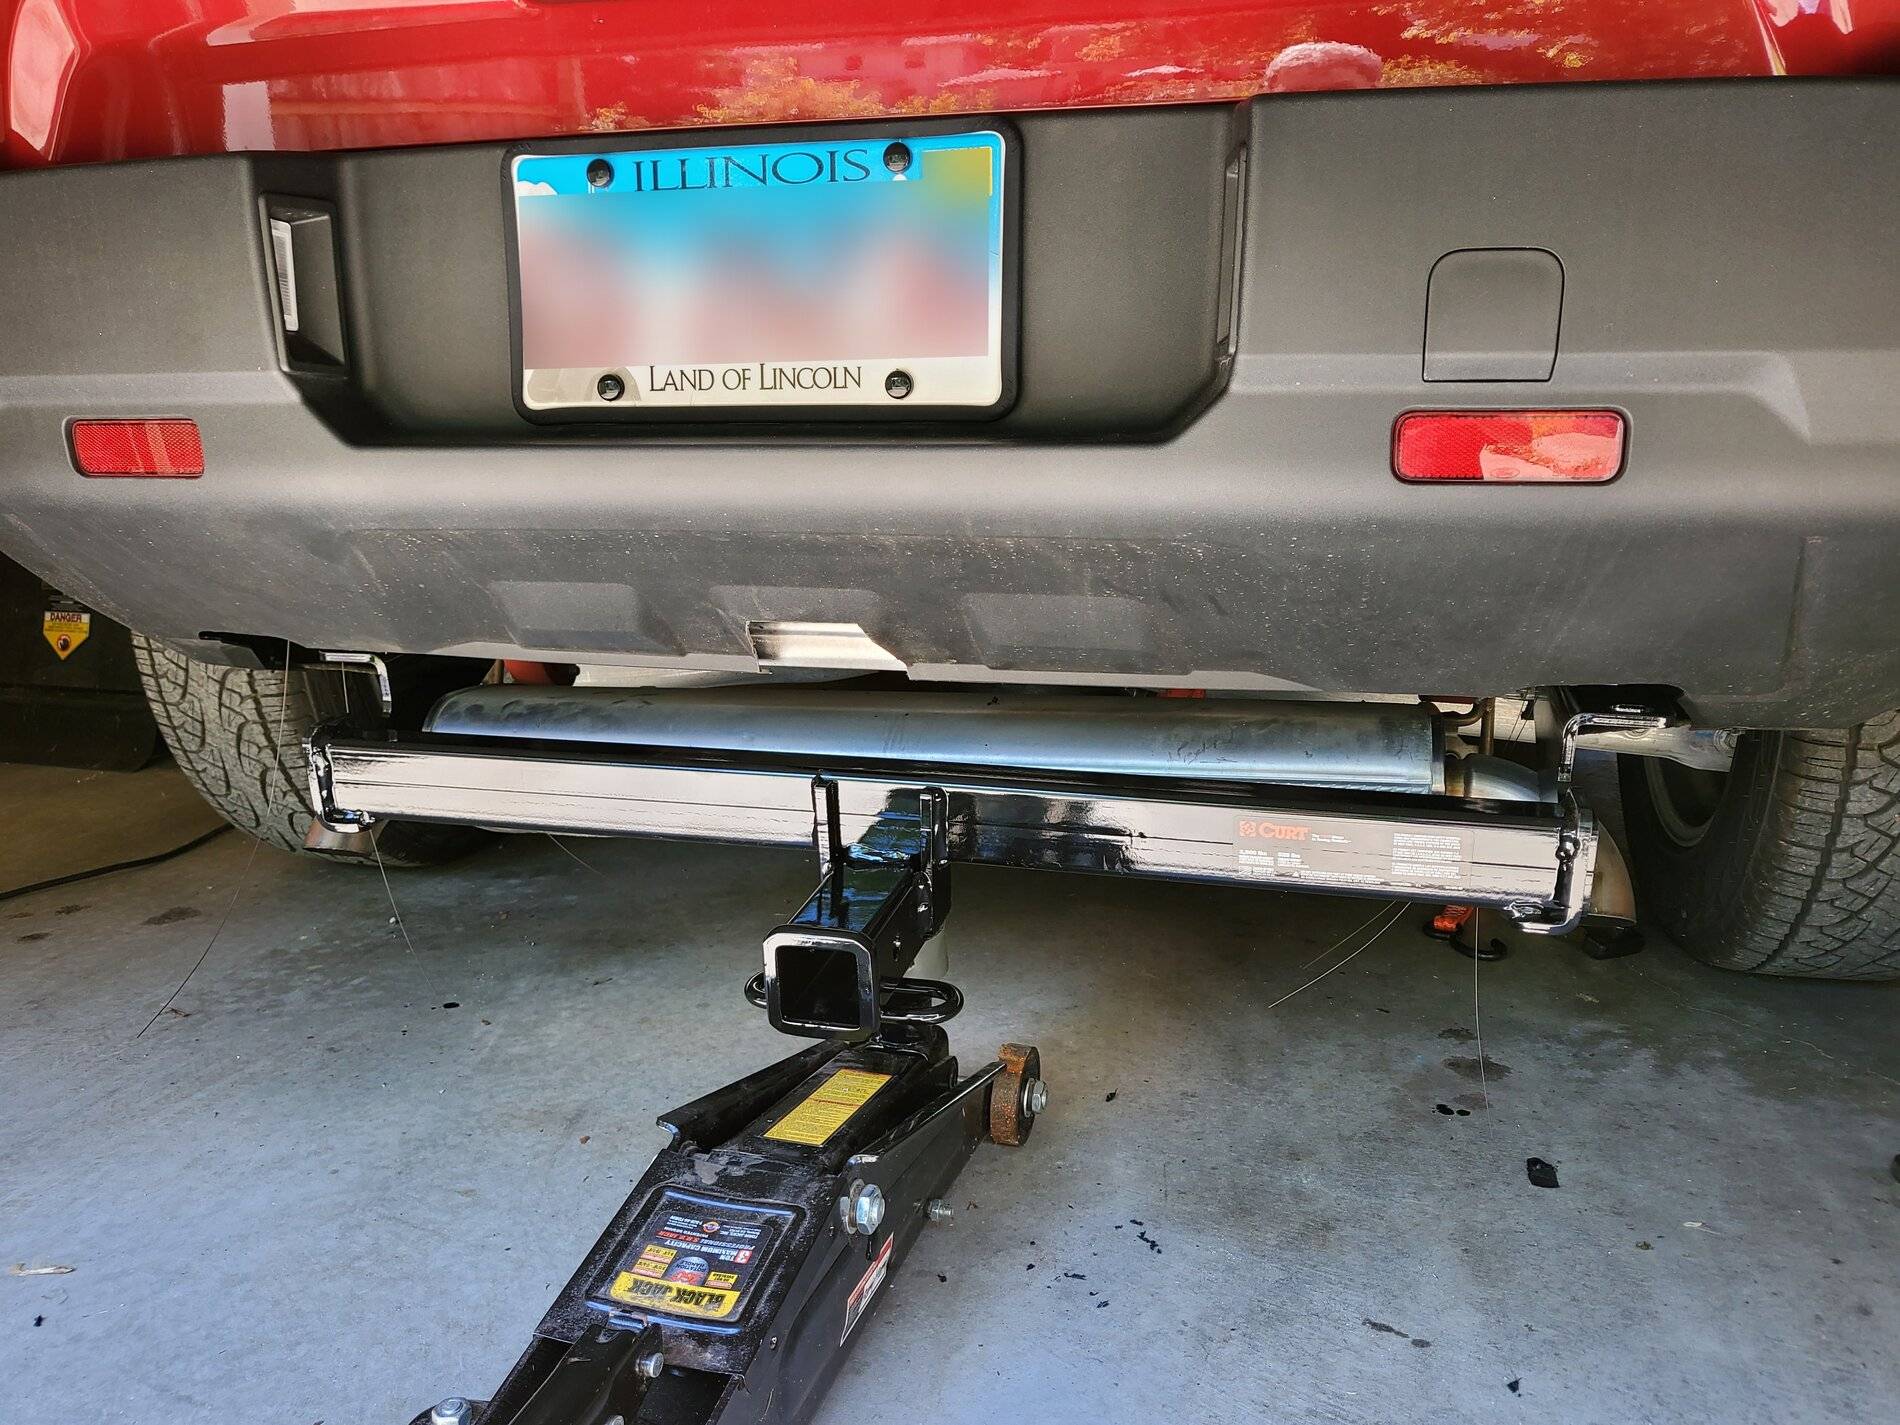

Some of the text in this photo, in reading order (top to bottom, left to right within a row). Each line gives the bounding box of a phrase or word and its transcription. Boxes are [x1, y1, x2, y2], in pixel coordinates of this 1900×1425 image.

[634, 149, 870, 192] ILLINOIS
[650, 363, 861, 392] LAND OF LINCOLN
[50, 612, 82, 622] DANGER
[625, 1279, 726, 1312] BLACK JACK
